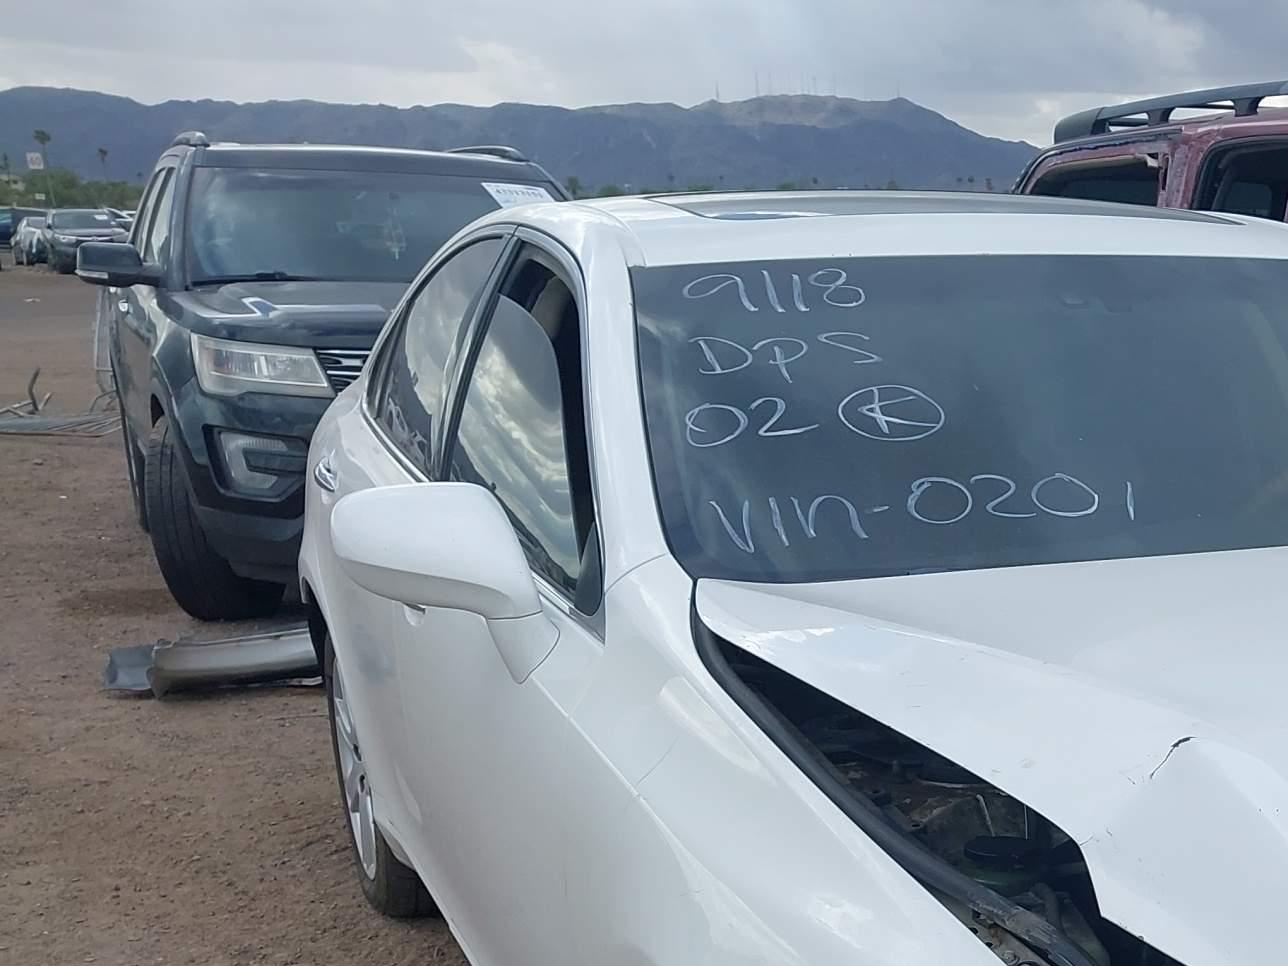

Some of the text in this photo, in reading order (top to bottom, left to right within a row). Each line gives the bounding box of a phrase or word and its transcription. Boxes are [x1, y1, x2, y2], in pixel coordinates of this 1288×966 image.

[683, 268, 866, 313] 9118
[688, 332, 882, 383] DPS
[684, 397, 820, 447] 02
